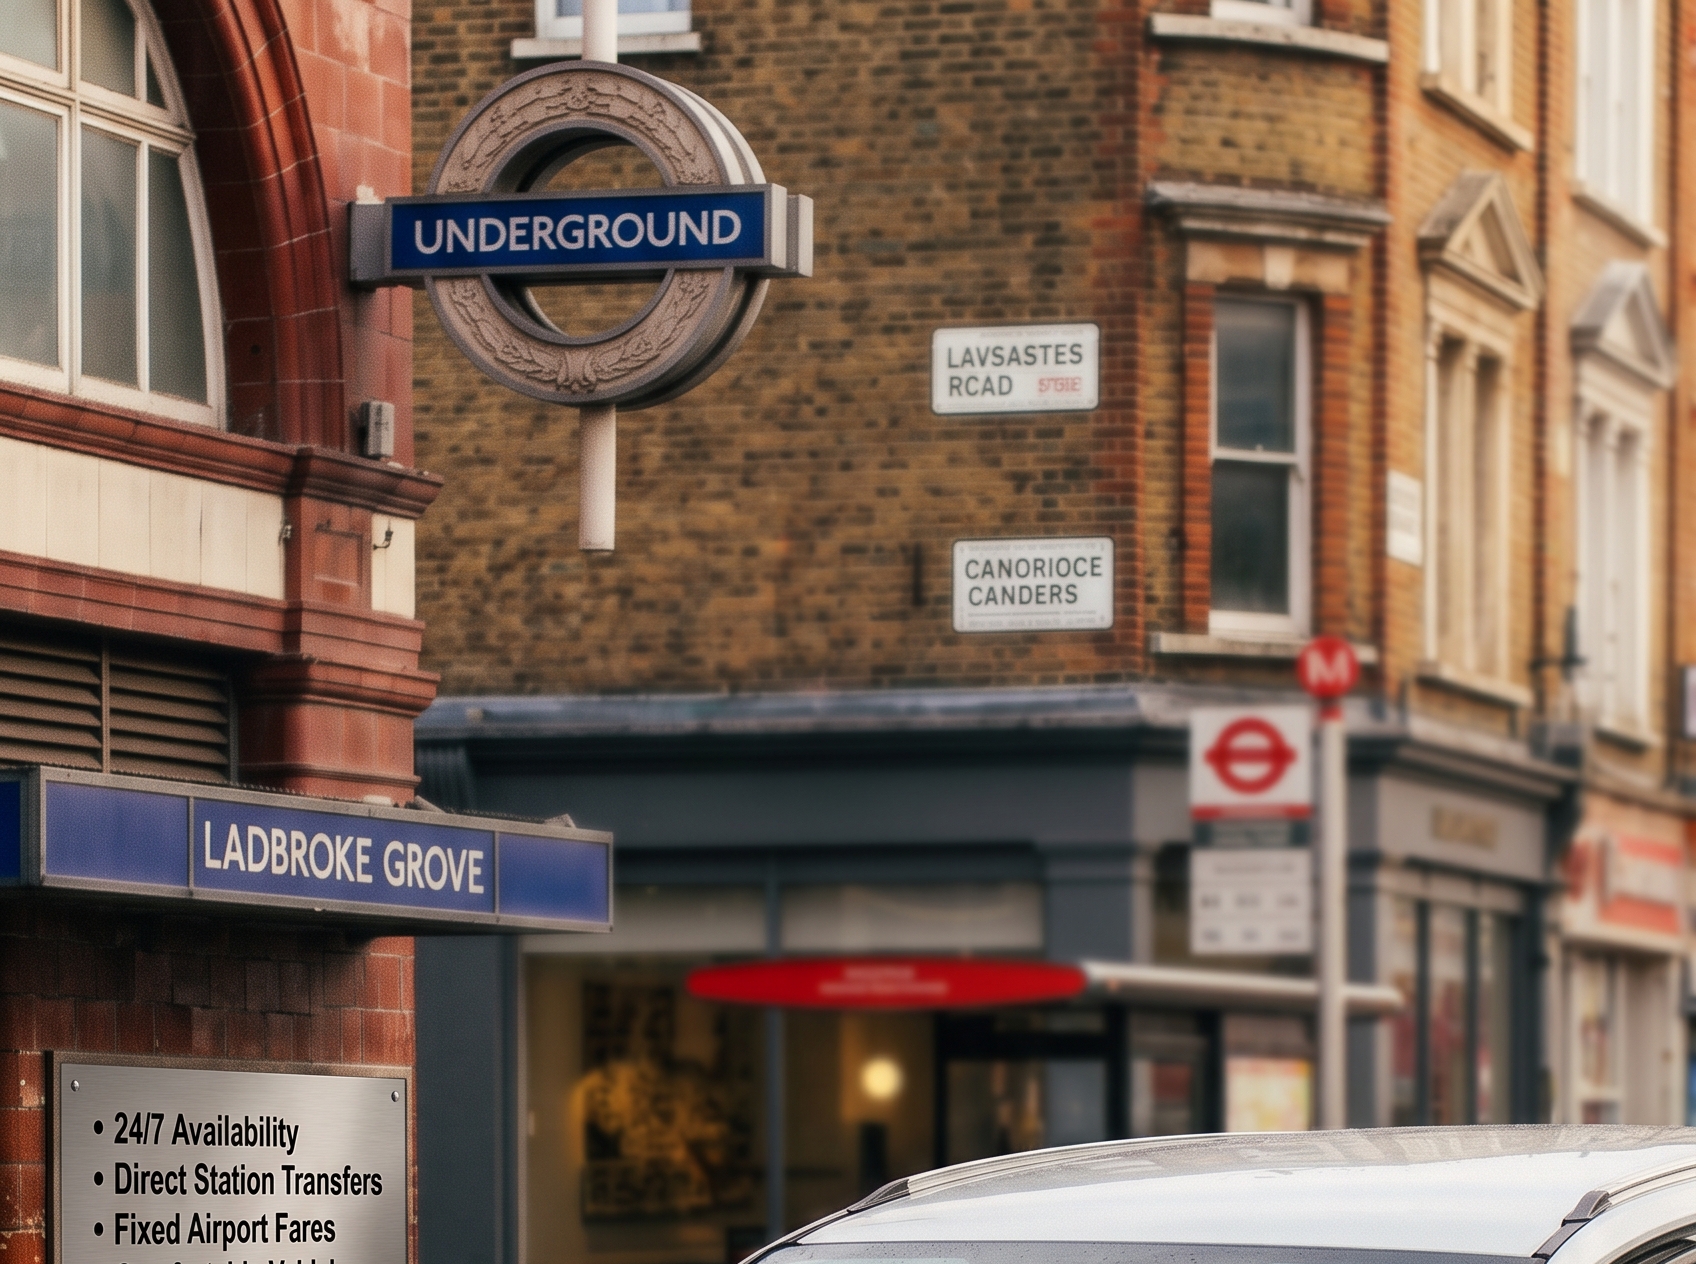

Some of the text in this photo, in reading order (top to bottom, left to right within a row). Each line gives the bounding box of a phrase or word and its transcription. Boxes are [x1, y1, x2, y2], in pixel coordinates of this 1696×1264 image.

[414, 209, 742, 255] UNDERGROUND
[947, 343, 1084, 369] LAVSASTES
[949, 375, 1014, 397] RCAD
[965, 556, 1103, 580] CANORIOCE
[968, 584, 1079, 606] CANDERS
[1305, 650, 1350, 688] M
[204, 820, 485, 894] LADBROKE GROVE
[114, 1112, 300, 1156] 24/7 Availability
[114, 1162, 383, 1196] Direct Station Transfers
[114, 1212, 336, 1252] Fixed Airport Fares
